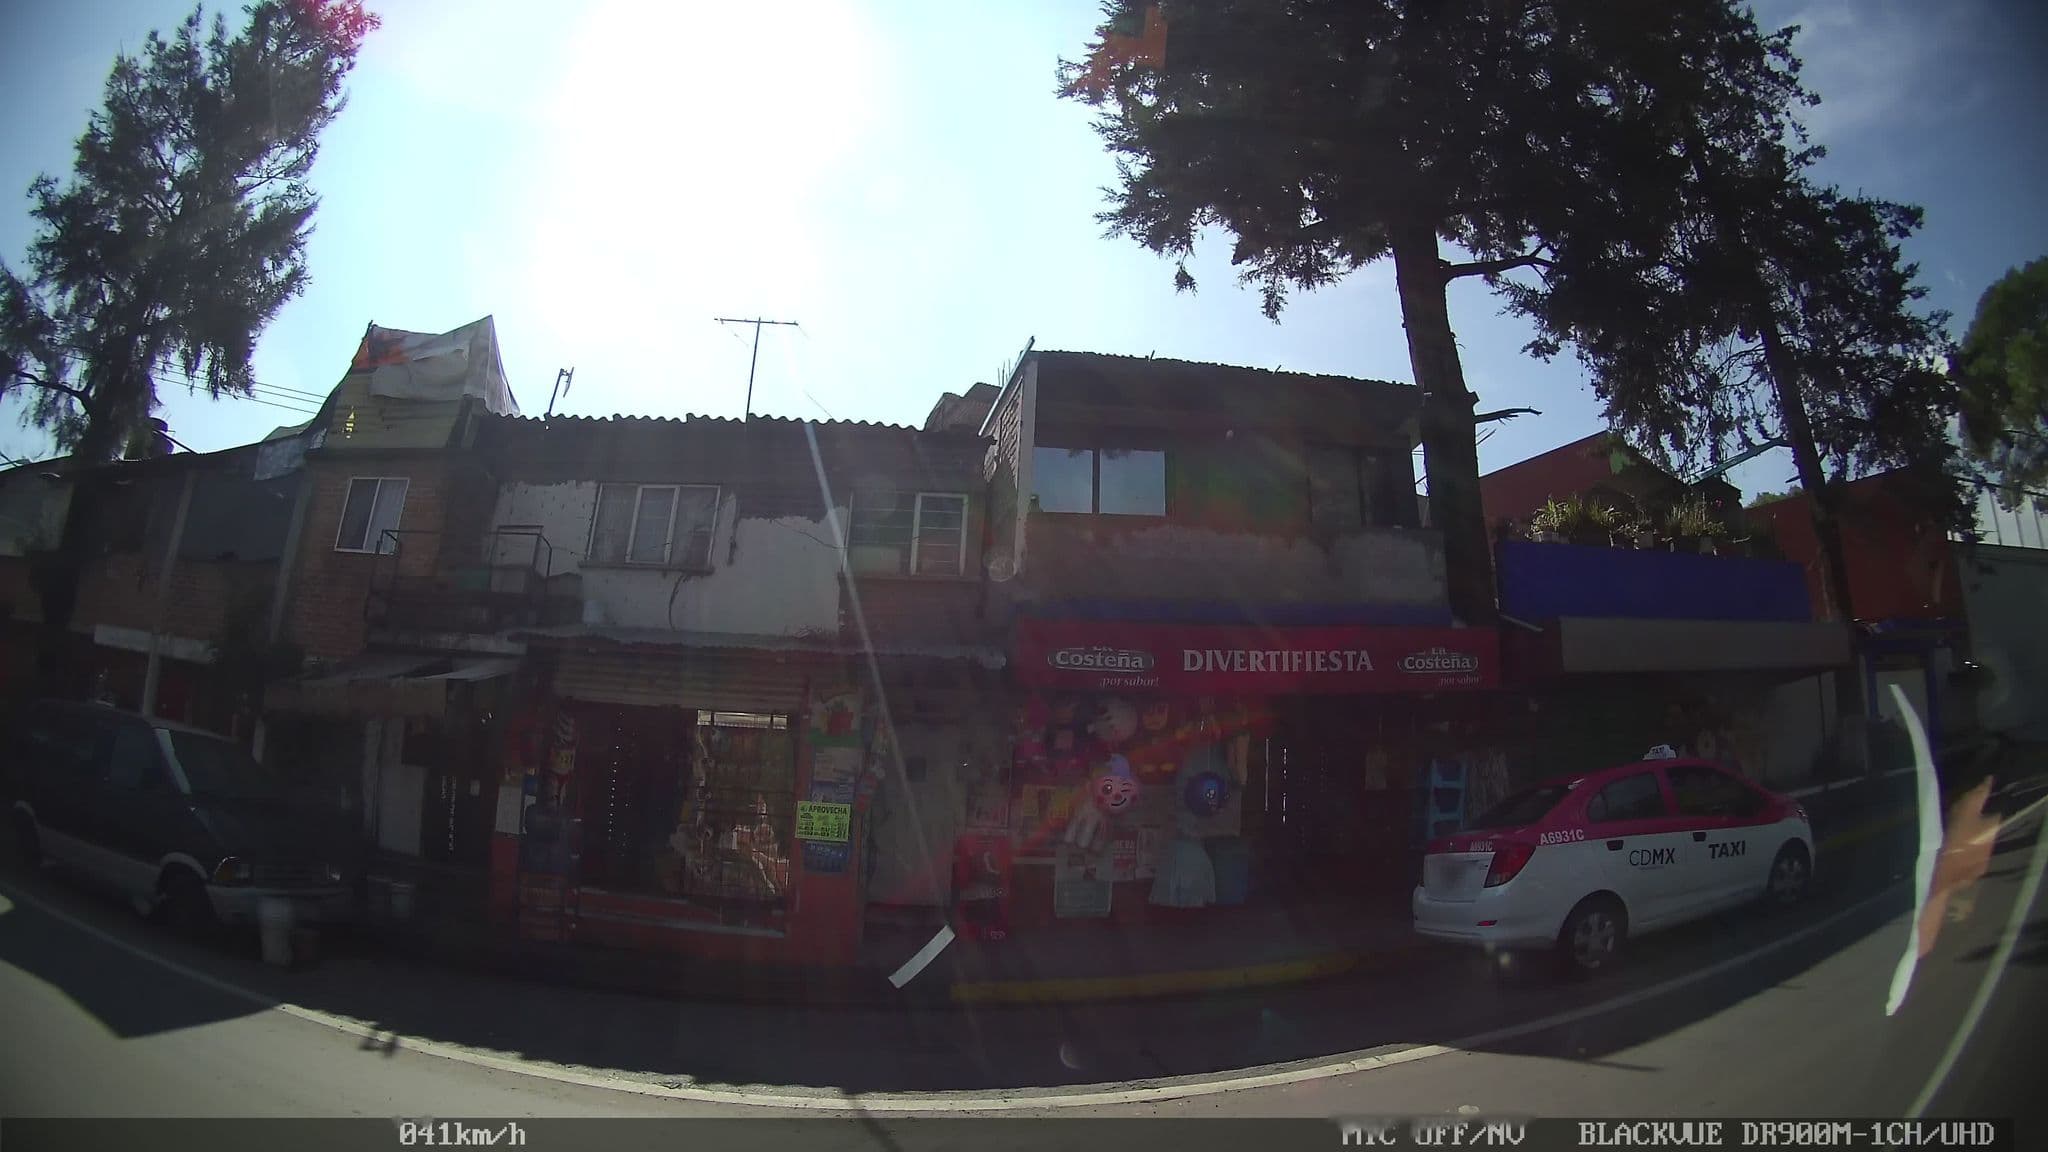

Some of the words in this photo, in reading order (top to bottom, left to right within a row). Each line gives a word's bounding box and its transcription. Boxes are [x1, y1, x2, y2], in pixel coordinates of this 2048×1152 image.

[1055, 650, 1145, 668] Costeña
[1183, 649, 1375, 672] DIVERTIFIESTA
[1403, 655, 1473, 670] Costeña
[808, 805, 847, 815] APROVECHA
[1539, 829, 1585, 845] A6931C
[1629, 848, 1676, 866] CDMX
[1708, 840, 1746, 859] TAXI
